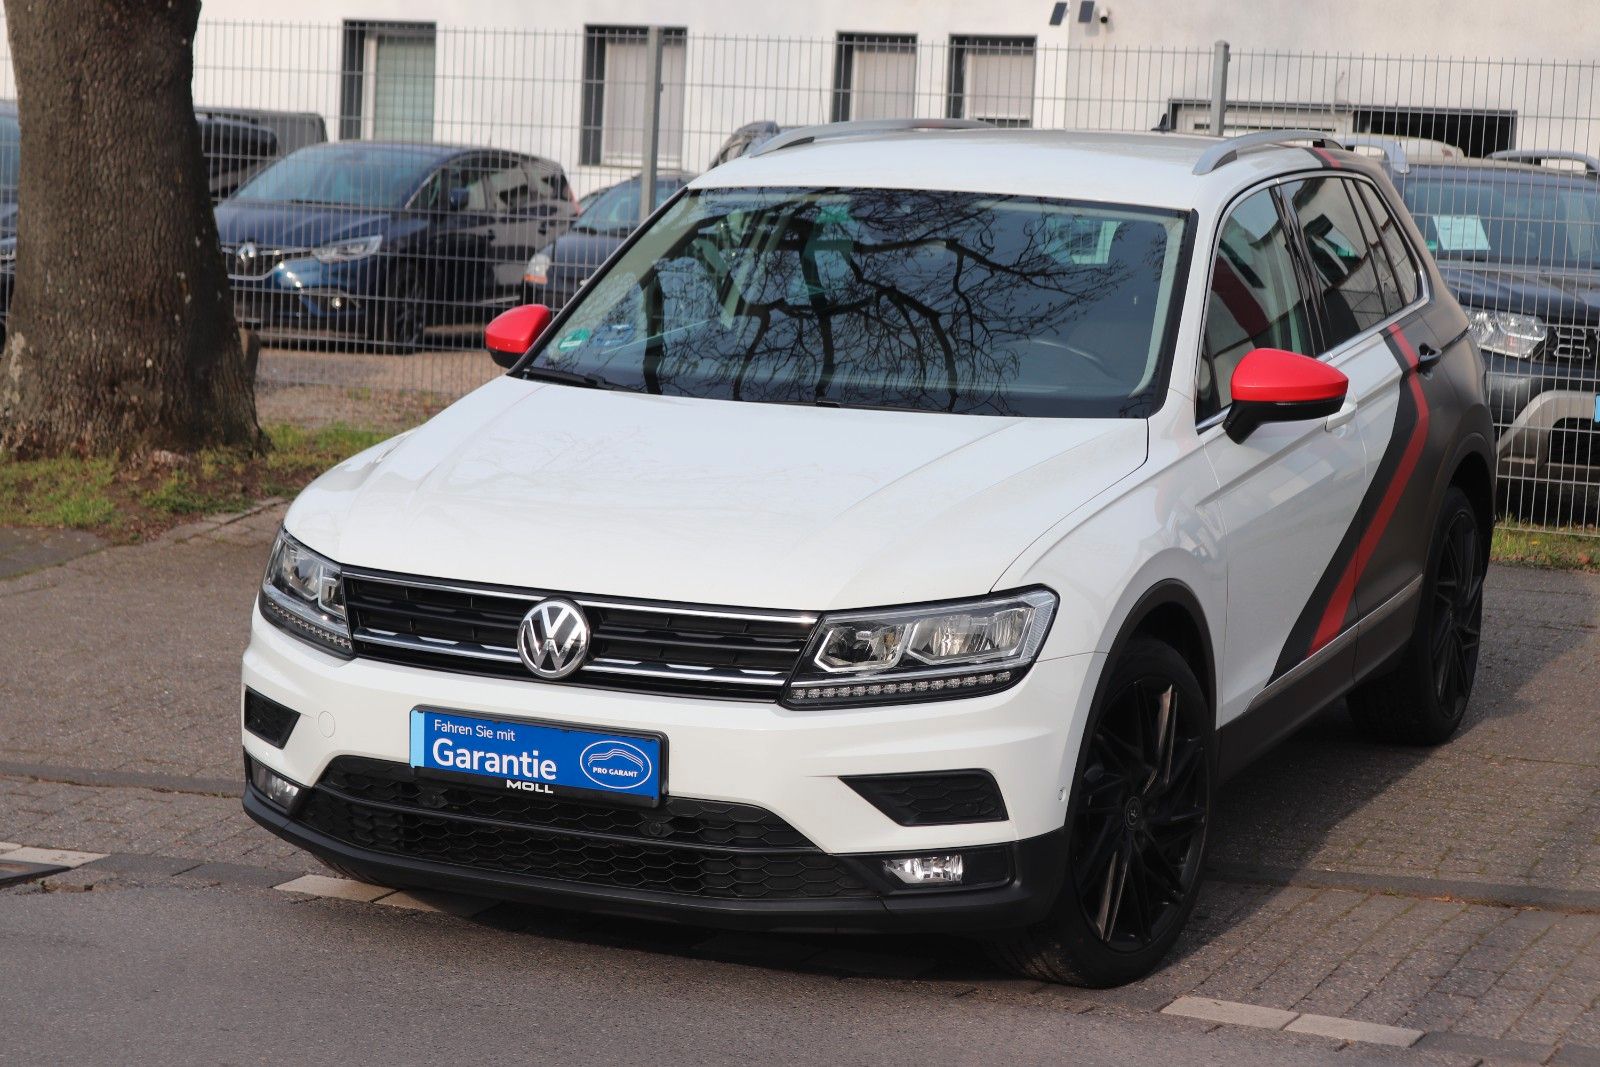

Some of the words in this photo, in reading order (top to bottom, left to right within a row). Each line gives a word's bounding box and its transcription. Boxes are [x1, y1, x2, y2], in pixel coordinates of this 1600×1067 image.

[434, 719, 473, 736] Fahren
[475, 725, 494, 739] Sie
[496, 729, 516, 742] mit
[432, 737, 557, 781] Garantie
[592, 766, 608, 775] PRO
[608, 768, 638, 778] GARANT
[506, 779, 554, 794] MOLL
